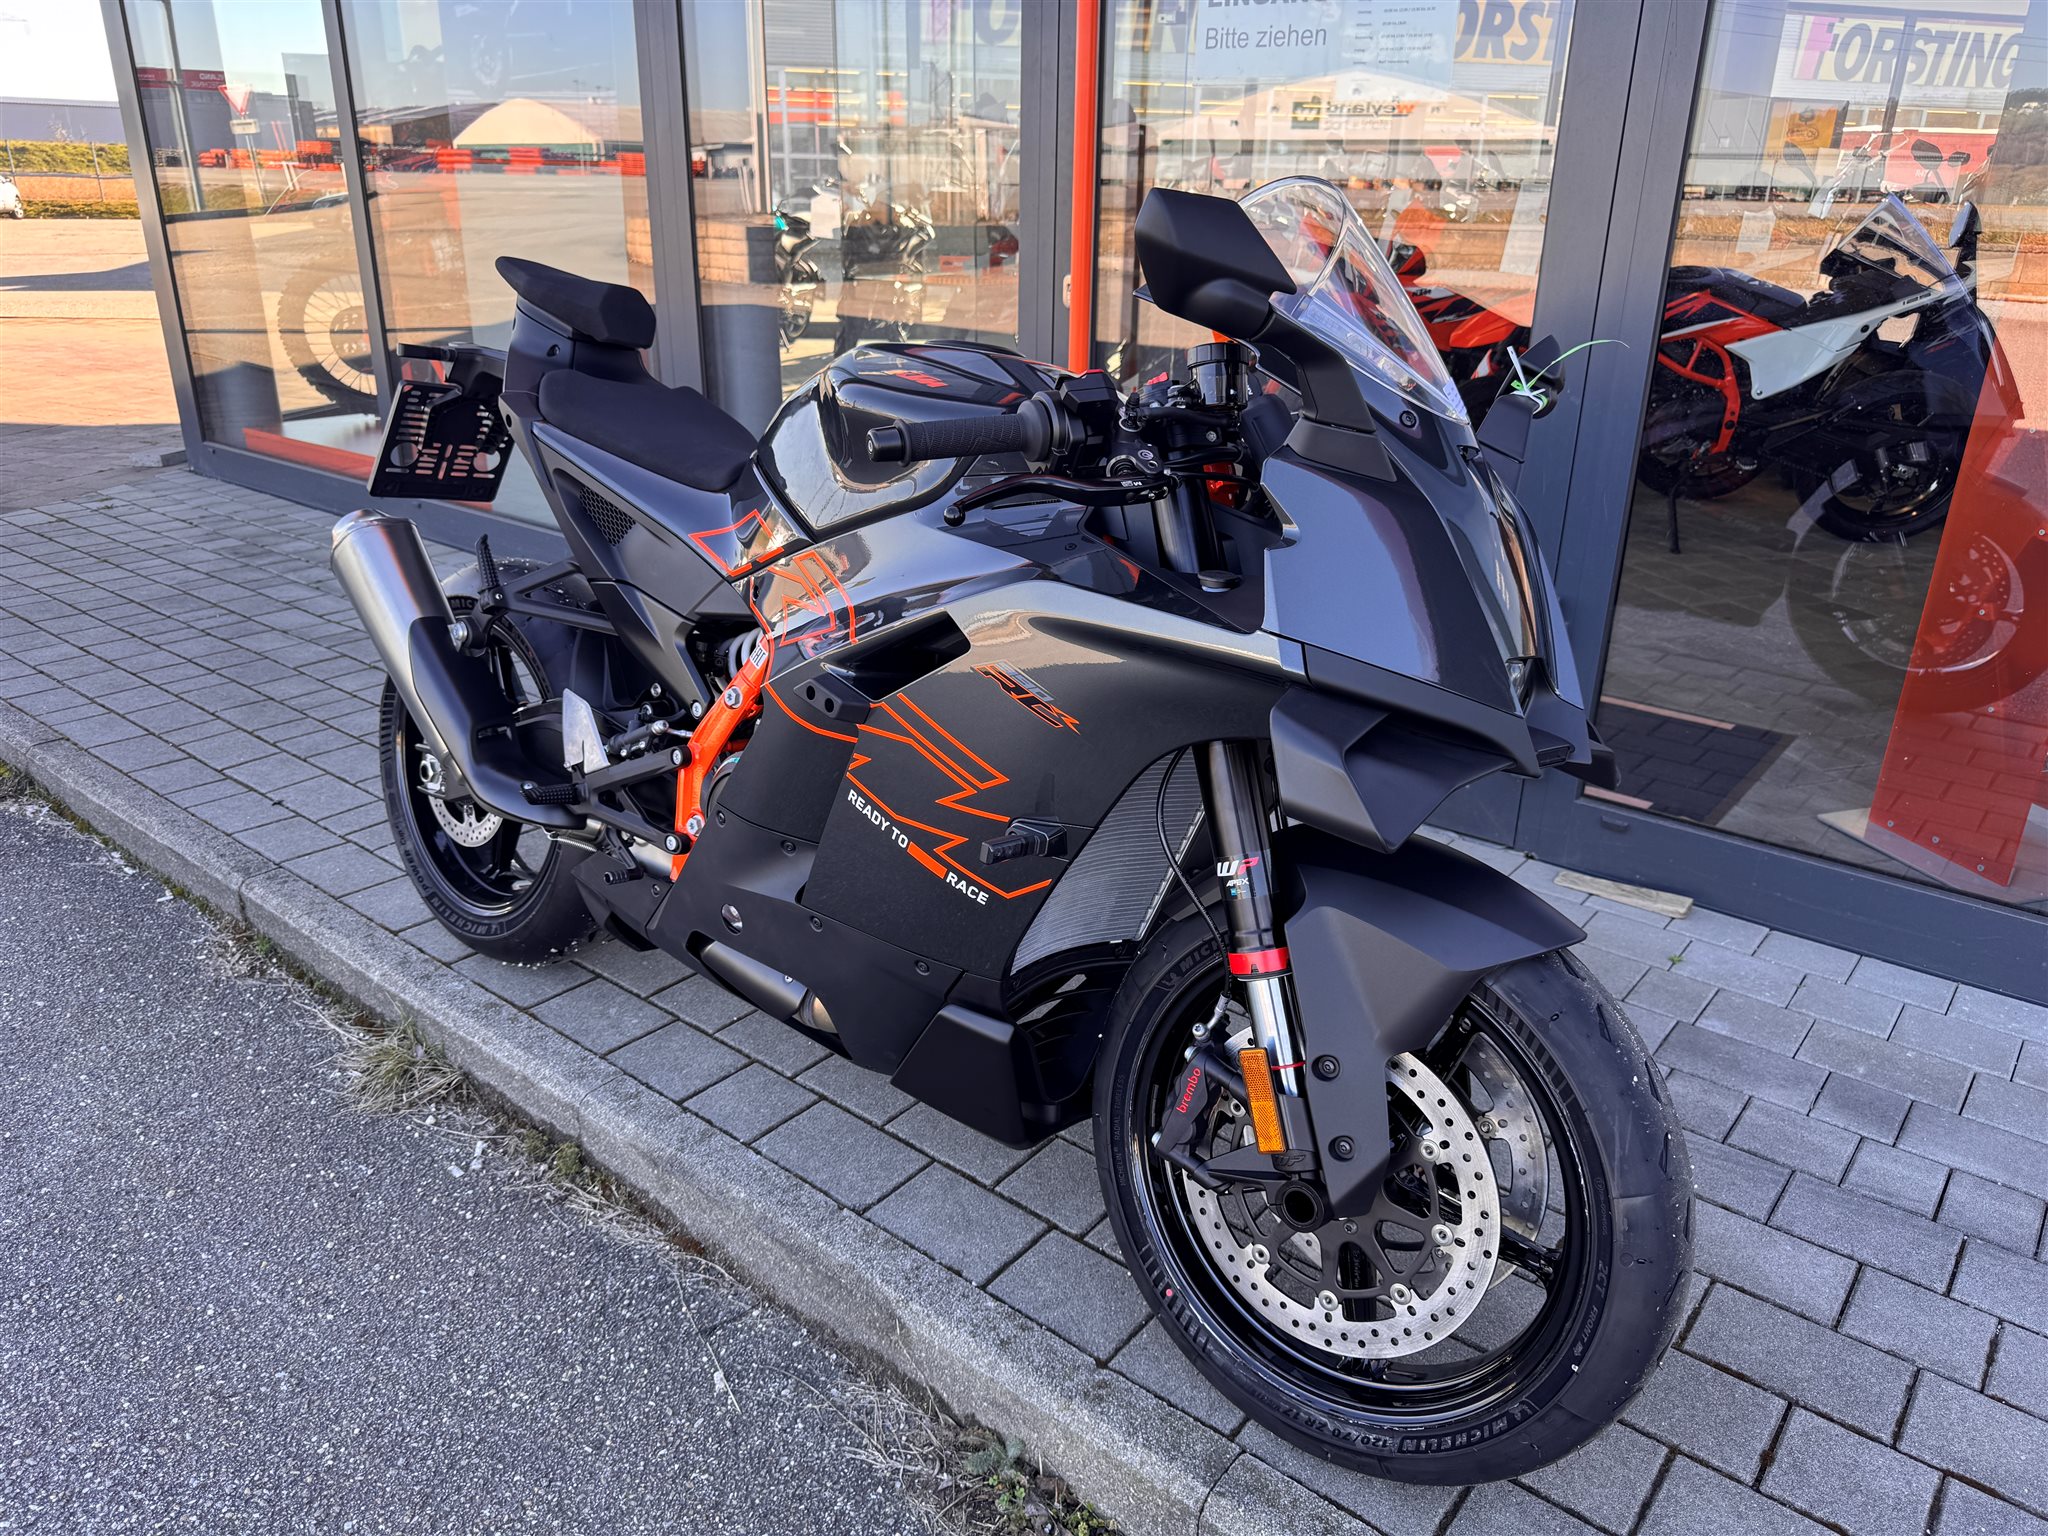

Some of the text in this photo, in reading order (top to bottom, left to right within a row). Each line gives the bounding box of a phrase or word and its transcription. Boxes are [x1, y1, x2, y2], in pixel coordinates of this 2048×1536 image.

[1205, 26, 1249, 49] Bitte
[1256, 24, 1327, 48] ziehen
[1796, 16, 2023, 88] FORSTING
[848, 789, 989, 905] READY TO RACE
[1217, 857, 1259, 876] WP
[404, 849, 430, 894] POWER
[1226, 878, 1249, 887] APEX
[430, 896, 487, 935] MICHELIN
[1176, 1067, 1201, 1114] brembo
[1282, 1408, 1508, 1451] MICHELIN 120/70 ZR 17
